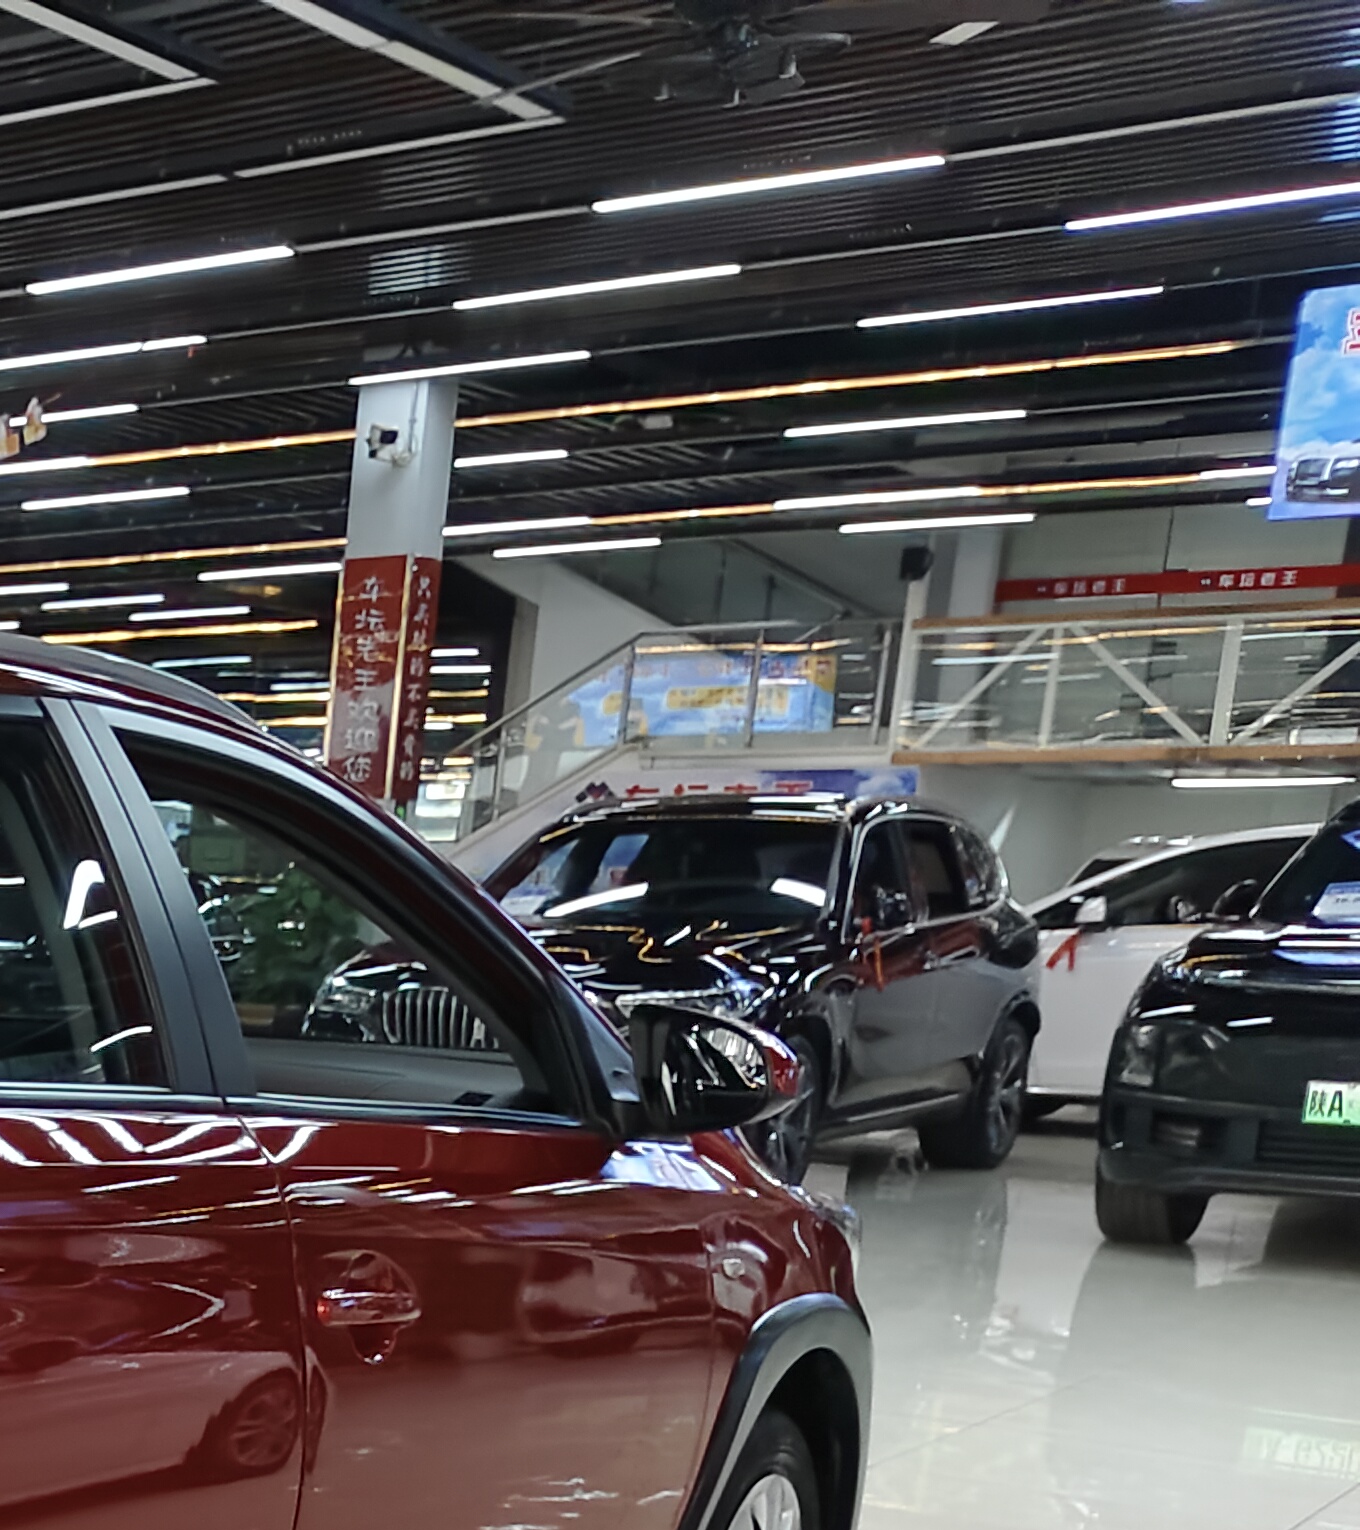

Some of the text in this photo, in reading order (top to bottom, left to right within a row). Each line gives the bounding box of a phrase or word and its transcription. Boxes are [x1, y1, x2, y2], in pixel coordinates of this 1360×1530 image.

[341, 575, 387, 784] 车坛老王欢迎您
